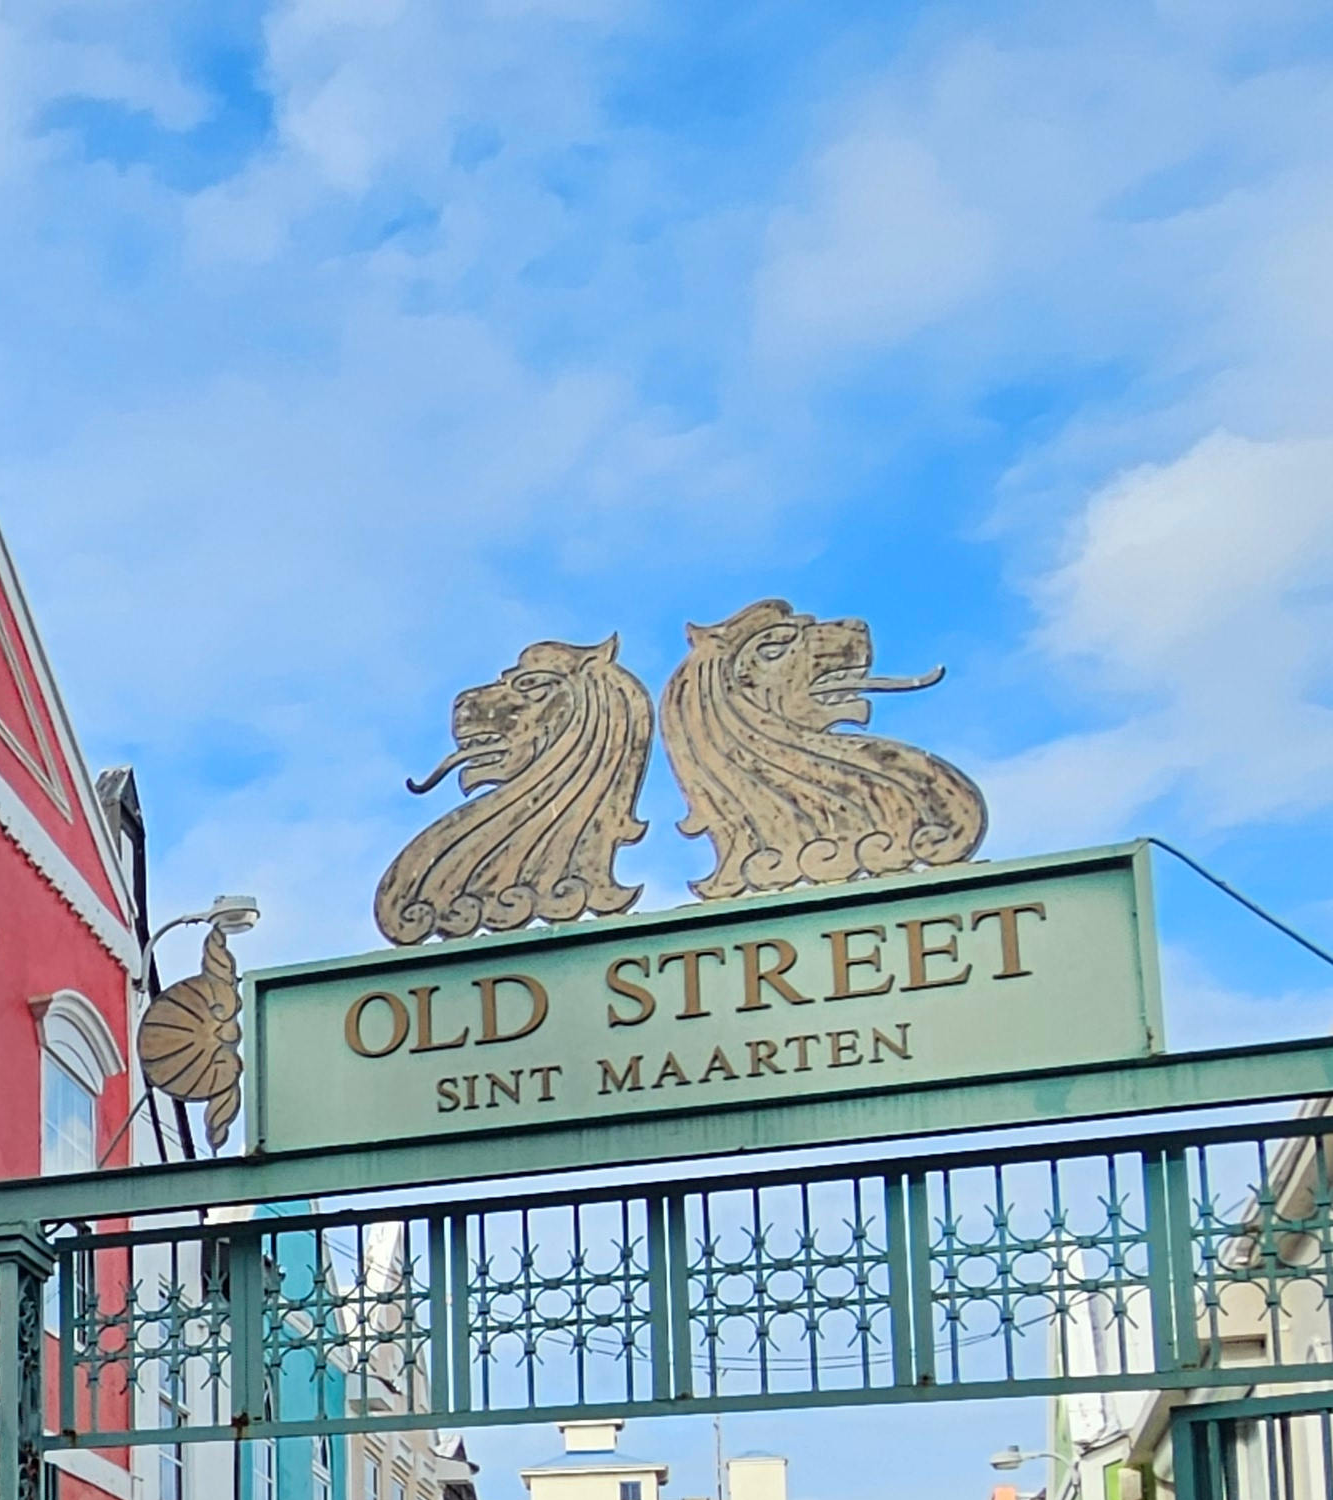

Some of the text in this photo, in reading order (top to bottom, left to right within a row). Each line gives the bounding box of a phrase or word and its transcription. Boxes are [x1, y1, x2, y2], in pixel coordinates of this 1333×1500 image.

[343, 901, 1047, 1059] OLD STREET
[436, 1022, 912, 1113] SINT MAARTEN
